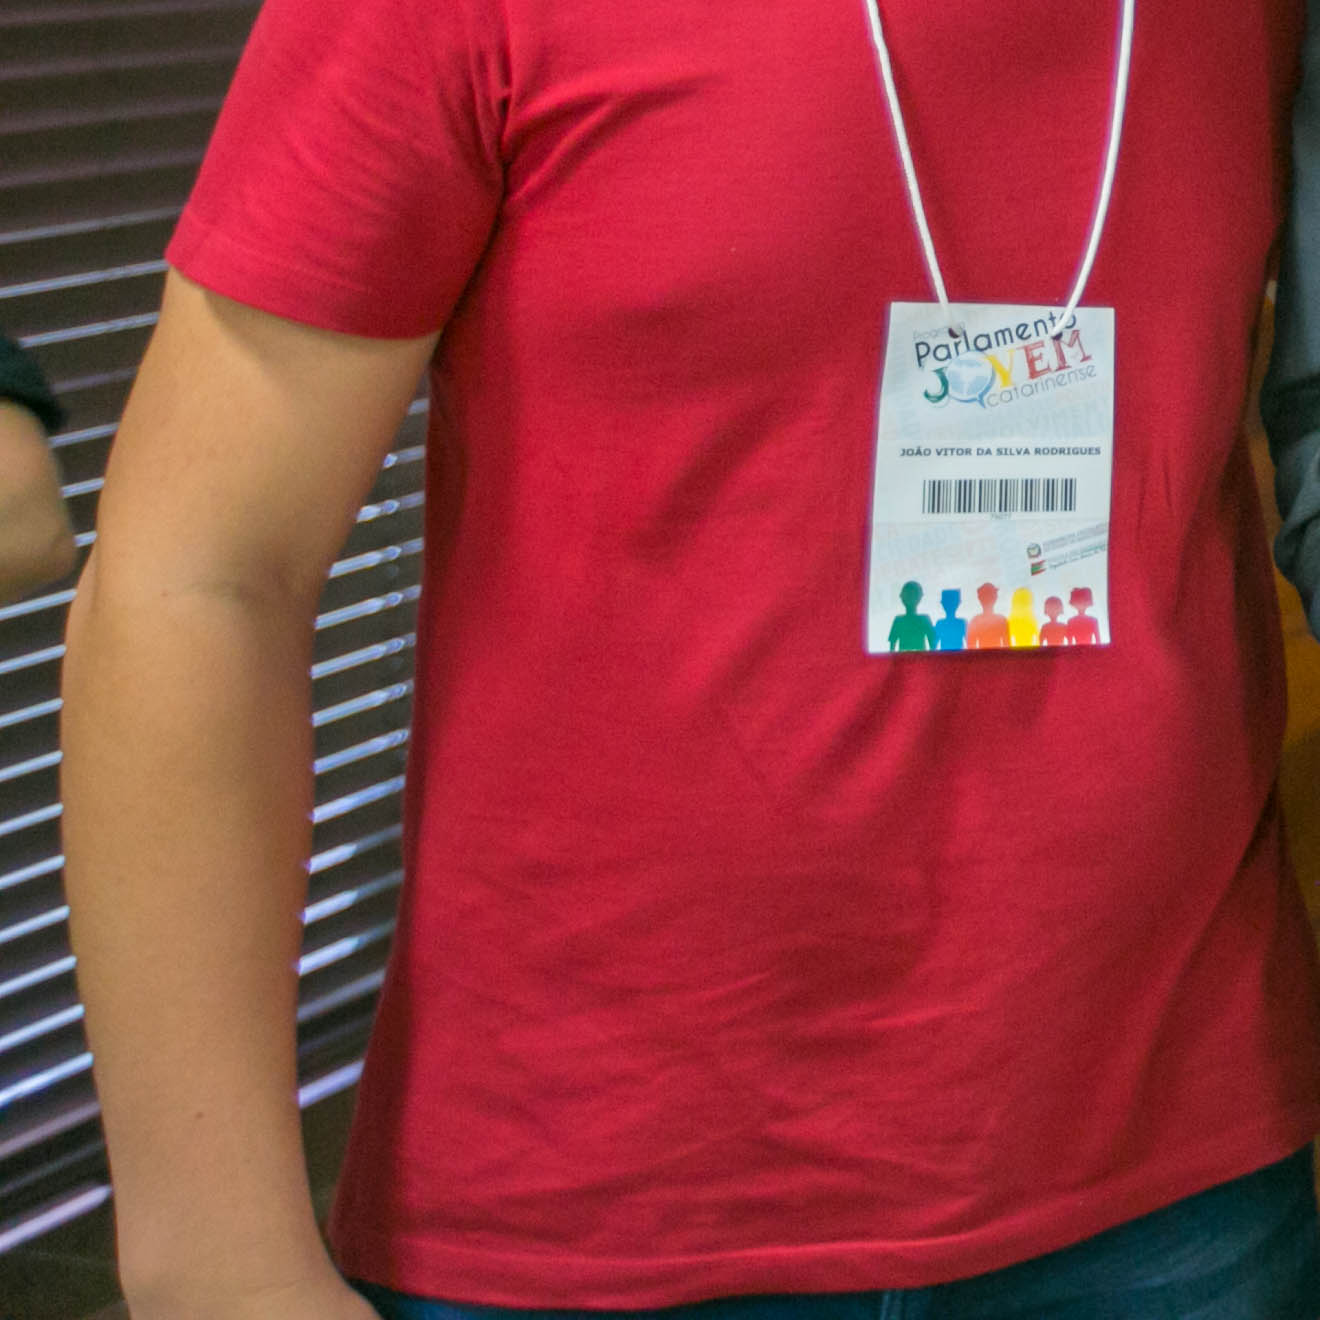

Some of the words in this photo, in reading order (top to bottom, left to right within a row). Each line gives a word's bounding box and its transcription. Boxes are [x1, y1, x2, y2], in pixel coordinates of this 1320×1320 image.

[914, 310, 1077, 368] Parlamento
[923, 329, 1092, 404] JOVEM
[986, 364, 1097, 408] catarinense
[900, 445, 931, 457] JOÃO
[935, 446, 972, 457] VITOR
[976, 446, 993, 457] DA
[996, 446, 1030, 456] SILVA
[1034, 446, 1101, 456] RODRIGUES
